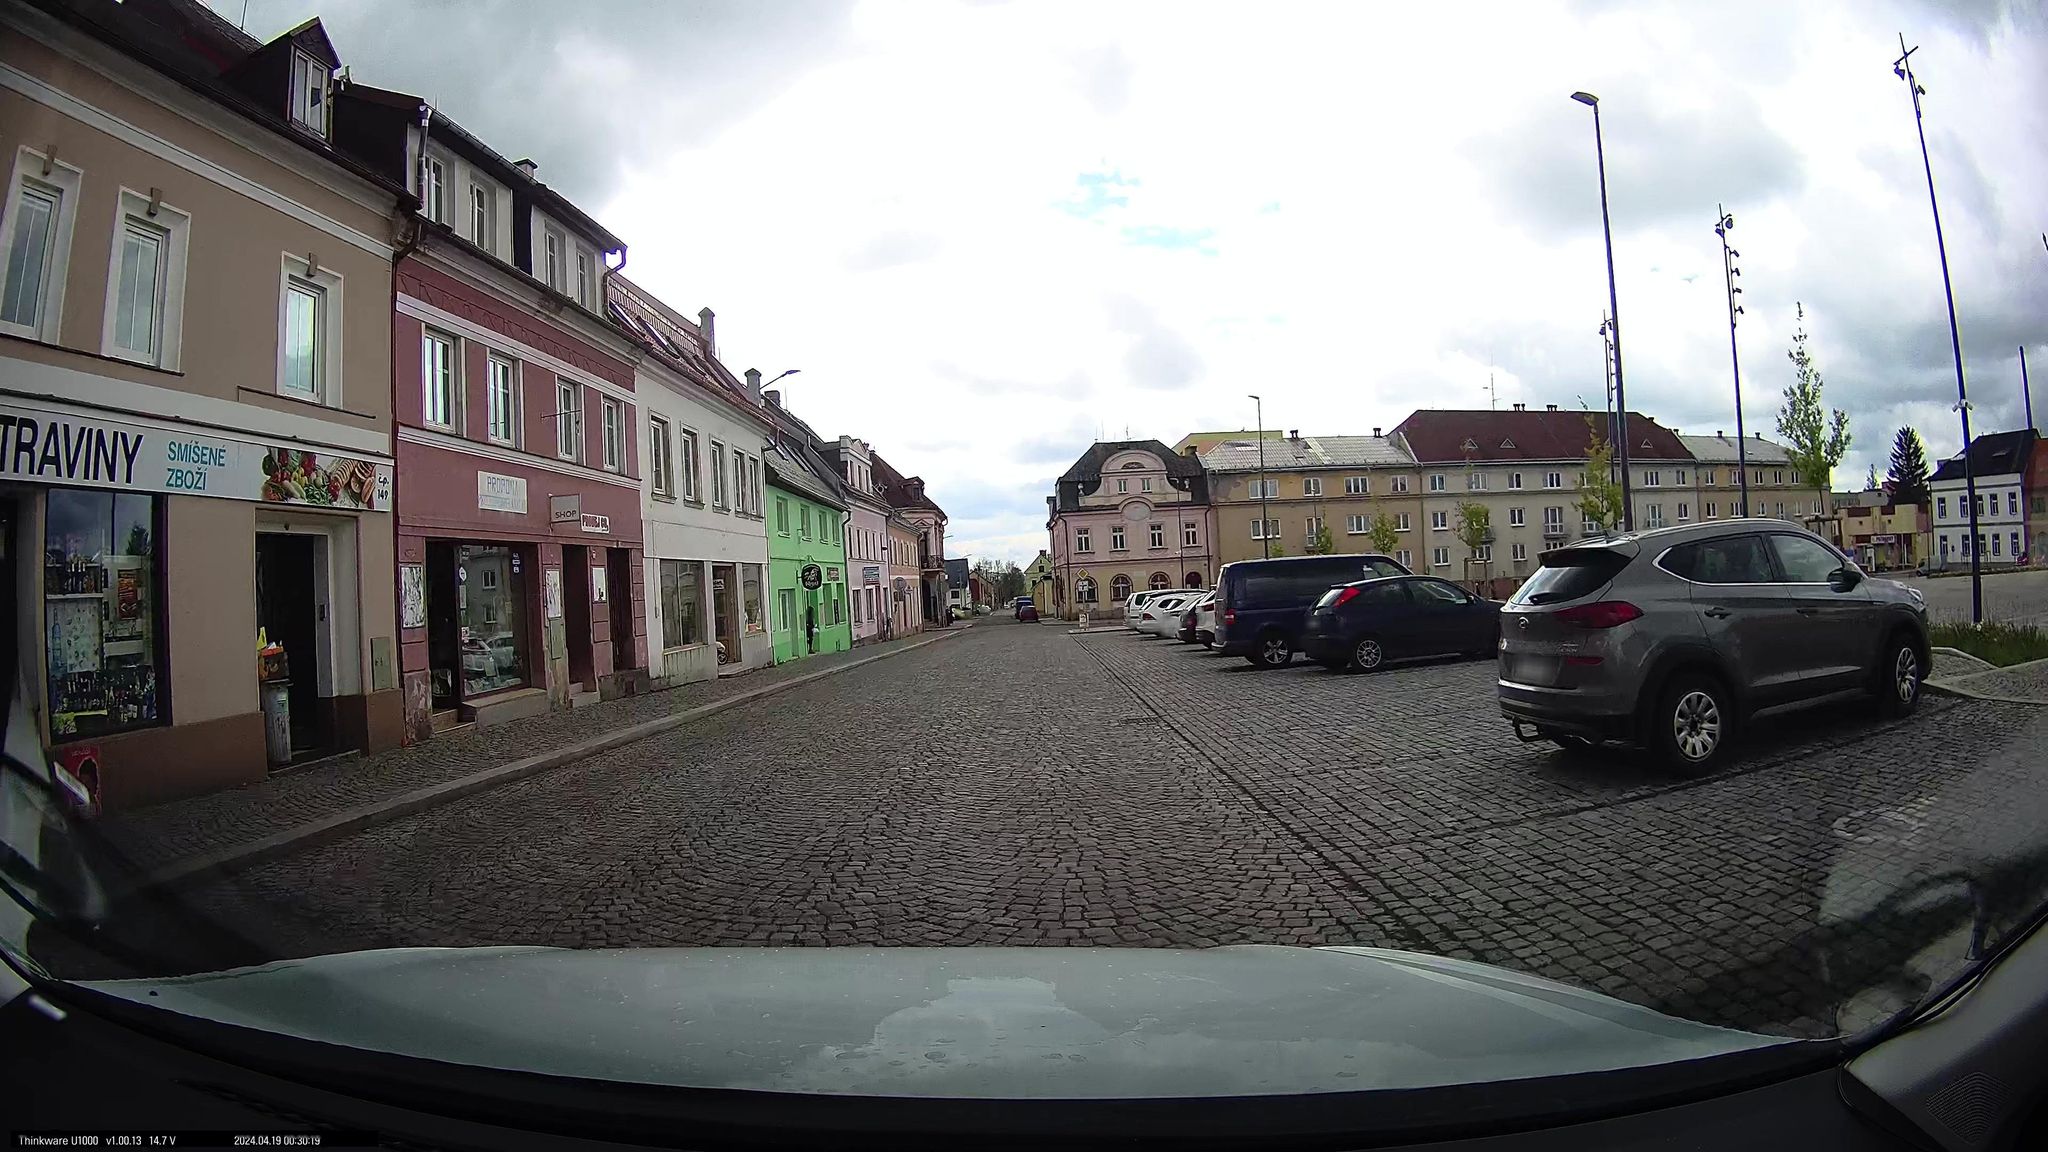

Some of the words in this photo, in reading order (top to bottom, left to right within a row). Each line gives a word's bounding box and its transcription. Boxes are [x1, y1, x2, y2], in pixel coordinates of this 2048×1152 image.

[0, 414, 144, 484] TRAVINY
[167, 440, 226, 467] SMÍŠENÉ
[166, 467, 208, 491] ZBOŽÍ
[377, 489, 388, 500] 149
[555, 510, 577, 519] SHOP
